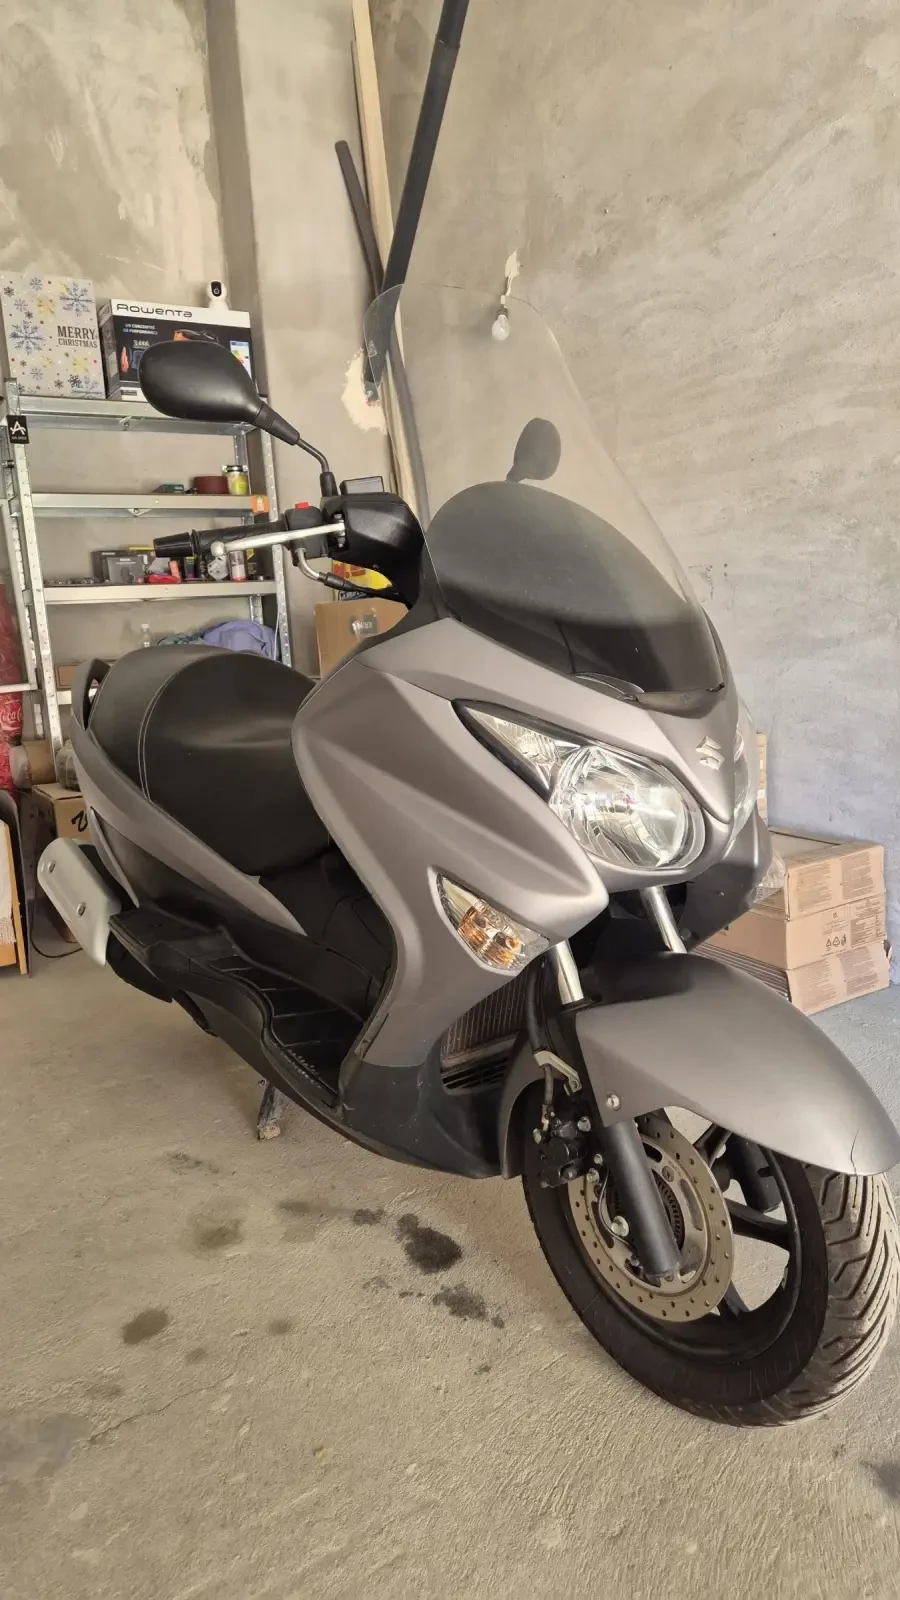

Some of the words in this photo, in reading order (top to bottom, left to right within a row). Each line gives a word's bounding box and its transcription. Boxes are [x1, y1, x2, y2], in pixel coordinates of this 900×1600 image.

[117, 304, 192, 318] Rowenta
[57, 325, 95, 340] MERRY
[58, 338, 97, 348] CHRISTMAS
